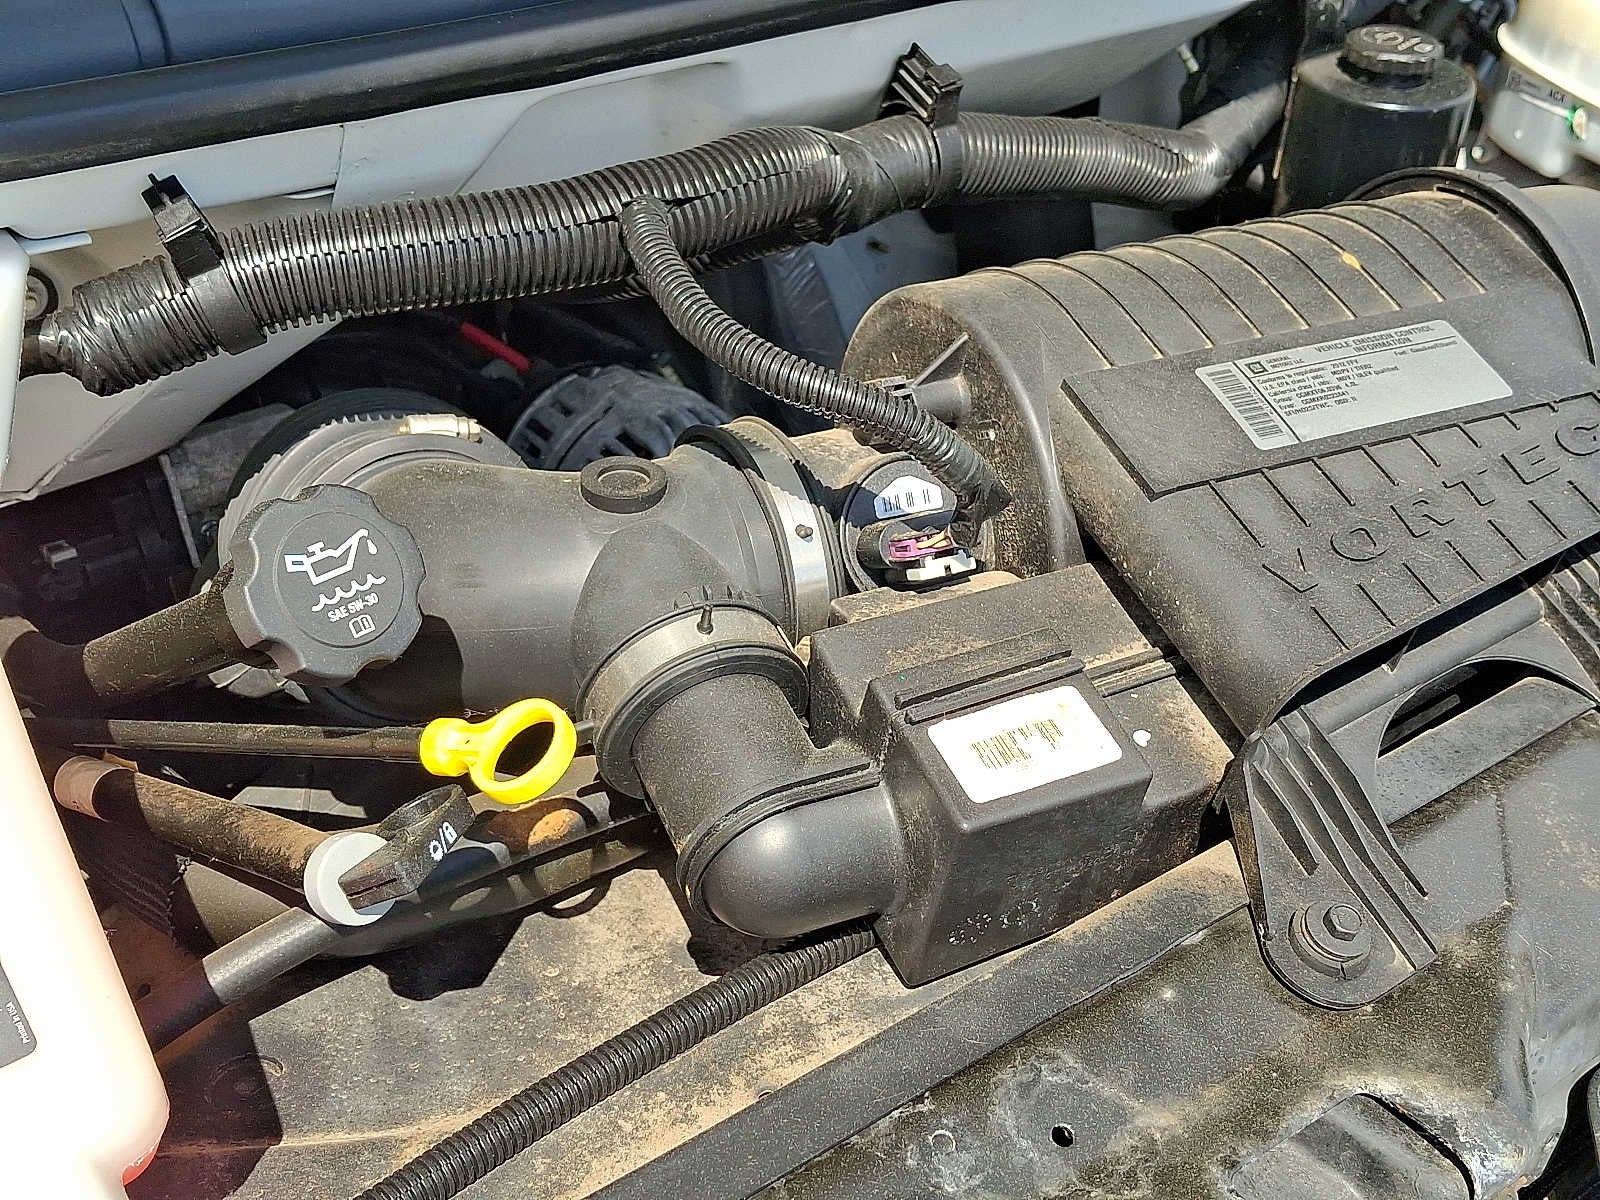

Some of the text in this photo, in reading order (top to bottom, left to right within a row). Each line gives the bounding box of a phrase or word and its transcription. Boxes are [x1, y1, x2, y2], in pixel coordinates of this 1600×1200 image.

[1314, 325, 1435, 353] VEHICLE EMISSION CONTROL
[1353, 337, 1413, 353] INFORMATION
[1257, 375, 1286, 384] Conforms
[1330, 360, 1346, 369] 2012
[1266, 356, 1291, 364] GENERAL
[1267, 387, 1297, 397] California
[1261, 412, 1600, 593] VORTEC
[327, 592, 379, 623] SAE 5W-30
